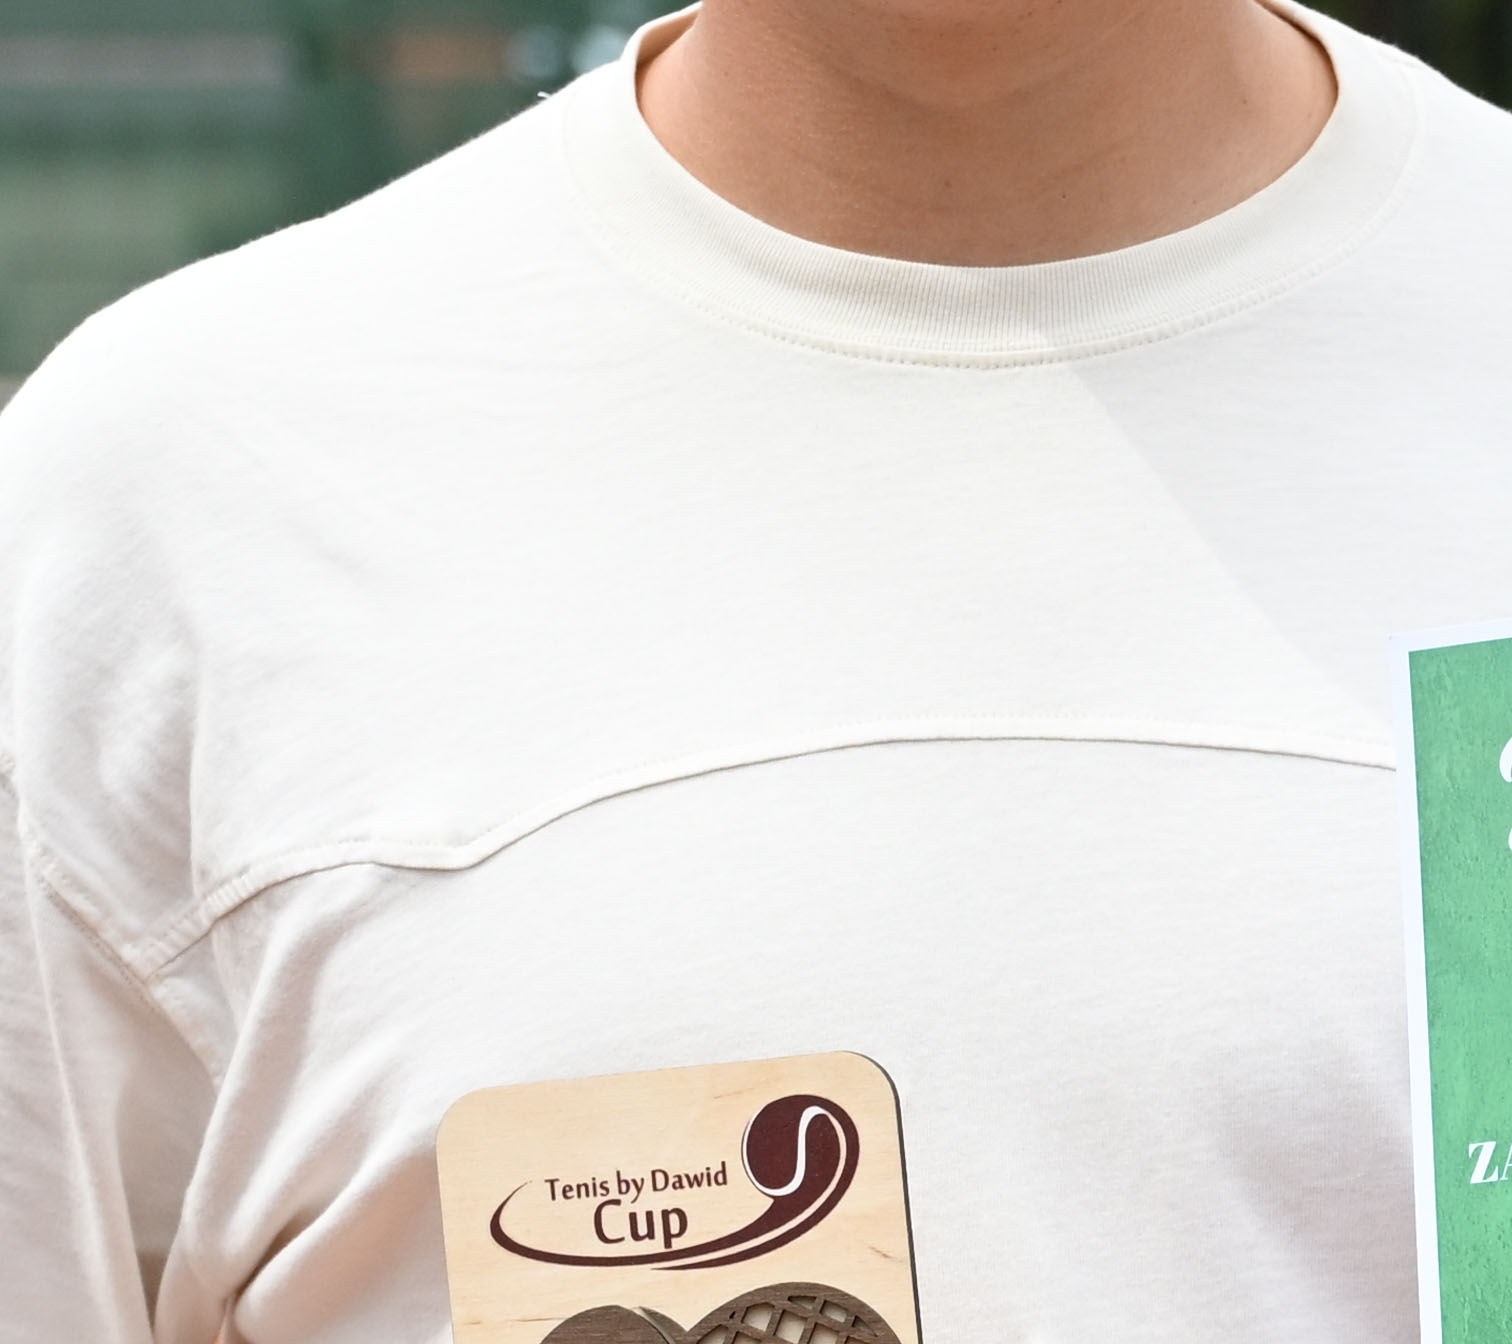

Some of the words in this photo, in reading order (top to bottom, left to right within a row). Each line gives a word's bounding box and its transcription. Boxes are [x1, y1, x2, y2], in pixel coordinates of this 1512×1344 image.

[544, 1174, 611, 1203] Tenis
[615, 1171, 645, 1204] by
[650, 1161, 729, 1192] Dawid
[592, 1198, 690, 1250] Cup
